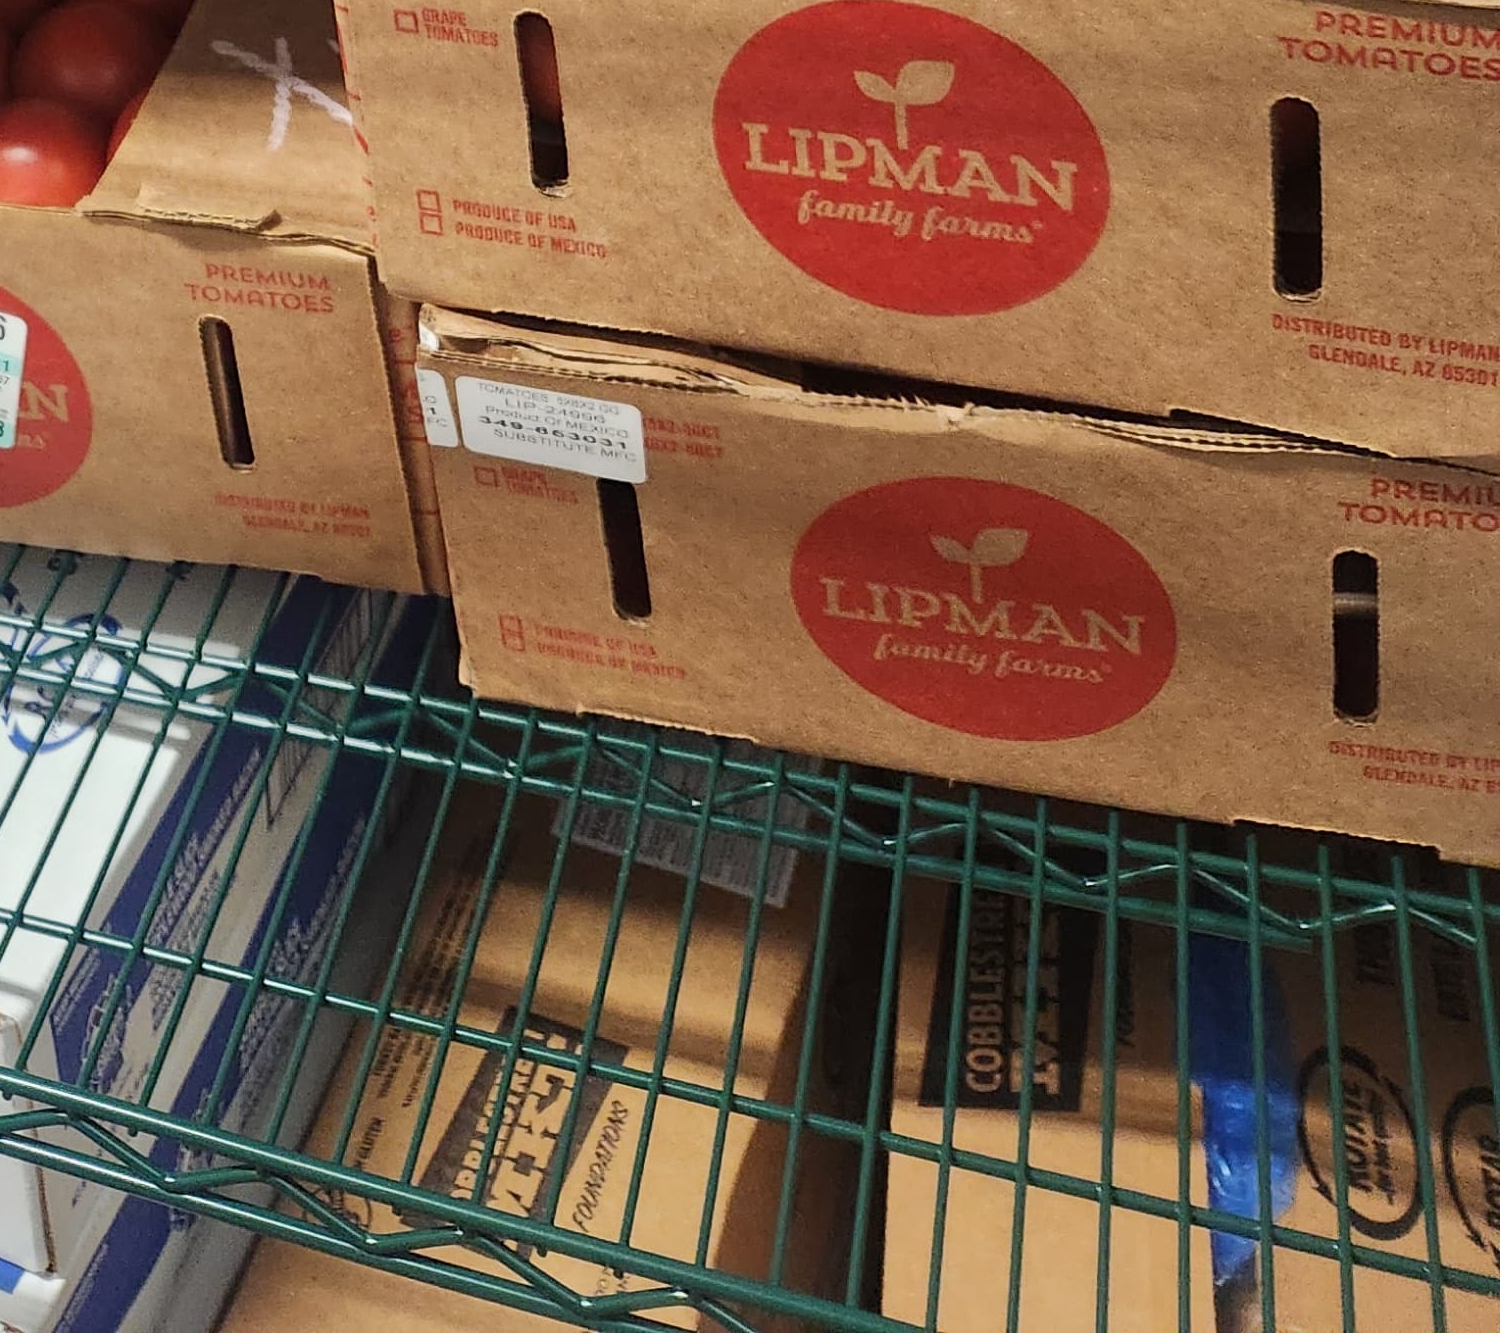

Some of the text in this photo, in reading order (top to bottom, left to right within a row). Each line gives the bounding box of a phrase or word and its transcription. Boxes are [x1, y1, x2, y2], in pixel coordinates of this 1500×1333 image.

[422, 8, 467, 25] GRAPE
[424, 24, 498, 47] TOMATOES
[1315, 10, 1500, 49] PREMIUM
[1276, 36, 1500, 81] TOMATOES
[742, 123, 1077, 212] LIPMAN
[452, 199, 577, 232] PRODUCE OF USA
[799, 190, 913, 237] family
[456, 221, 608, 258] PRODUCE OF MEXICO
[205, 263, 329, 291] PREMIUM
[184, 283, 335, 314] TOMATOES
[1271, 313, 1500, 364] DISTRIBUTED BY LIPMAN
[1308, 344, 1499, 387] GLENDALE, AZ 85301
[493, 429, 593, 455] SUBSTITUTE
[564, 416, 629, 438] MEXICO
[820, 577, 1144, 655] LIPMAN
[874, 635, 988, 674] family
[573, 1099, 629, 1232] FOUNDATIONS
